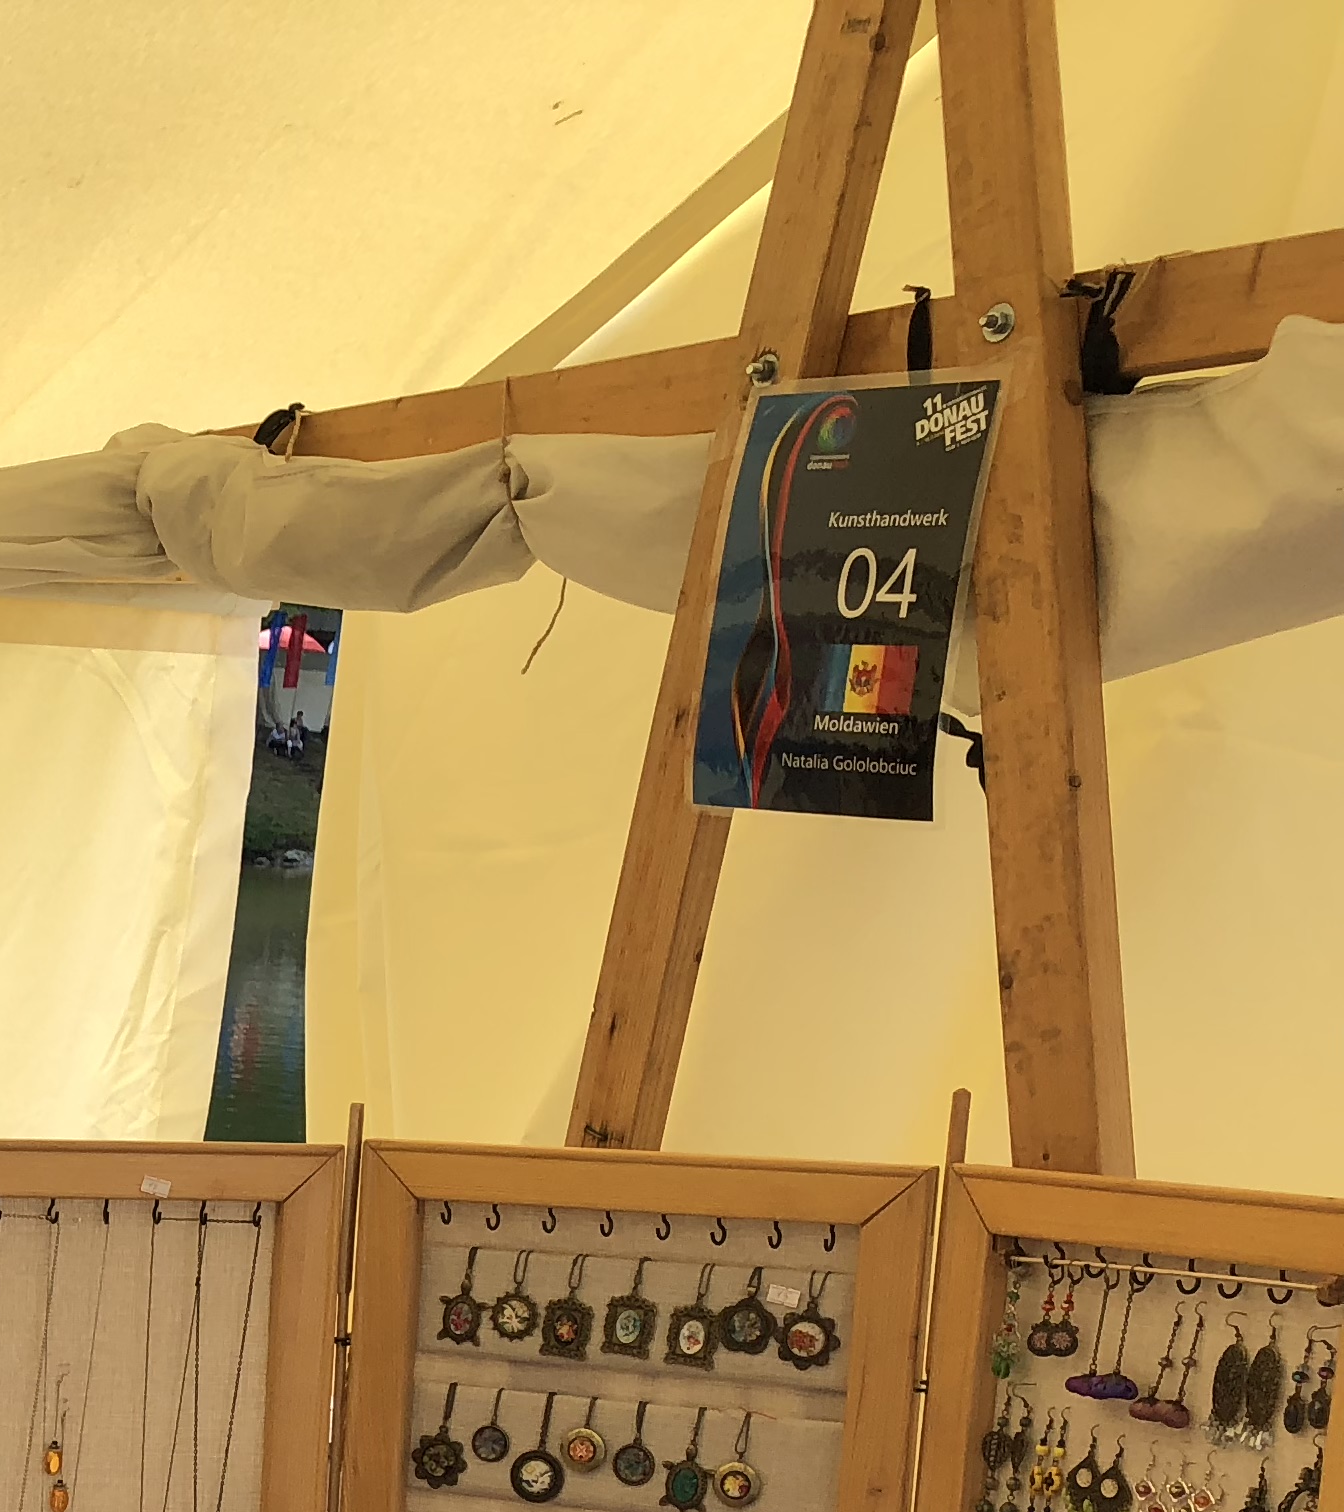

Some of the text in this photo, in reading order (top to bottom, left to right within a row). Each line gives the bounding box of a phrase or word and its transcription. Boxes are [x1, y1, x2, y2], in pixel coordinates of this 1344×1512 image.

[923, 393, 946, 416] 11.
[915, 393, 985, 441] DONAU
[945, 410, 989, 446] FEST
[828, 508, 949, 528] Kunsthandwerk
[837, 547, 917, 618] 04
[813, 714, 899, 735] Moldawien
[781, 752, 918, 776] Natalia Gololobciuc
